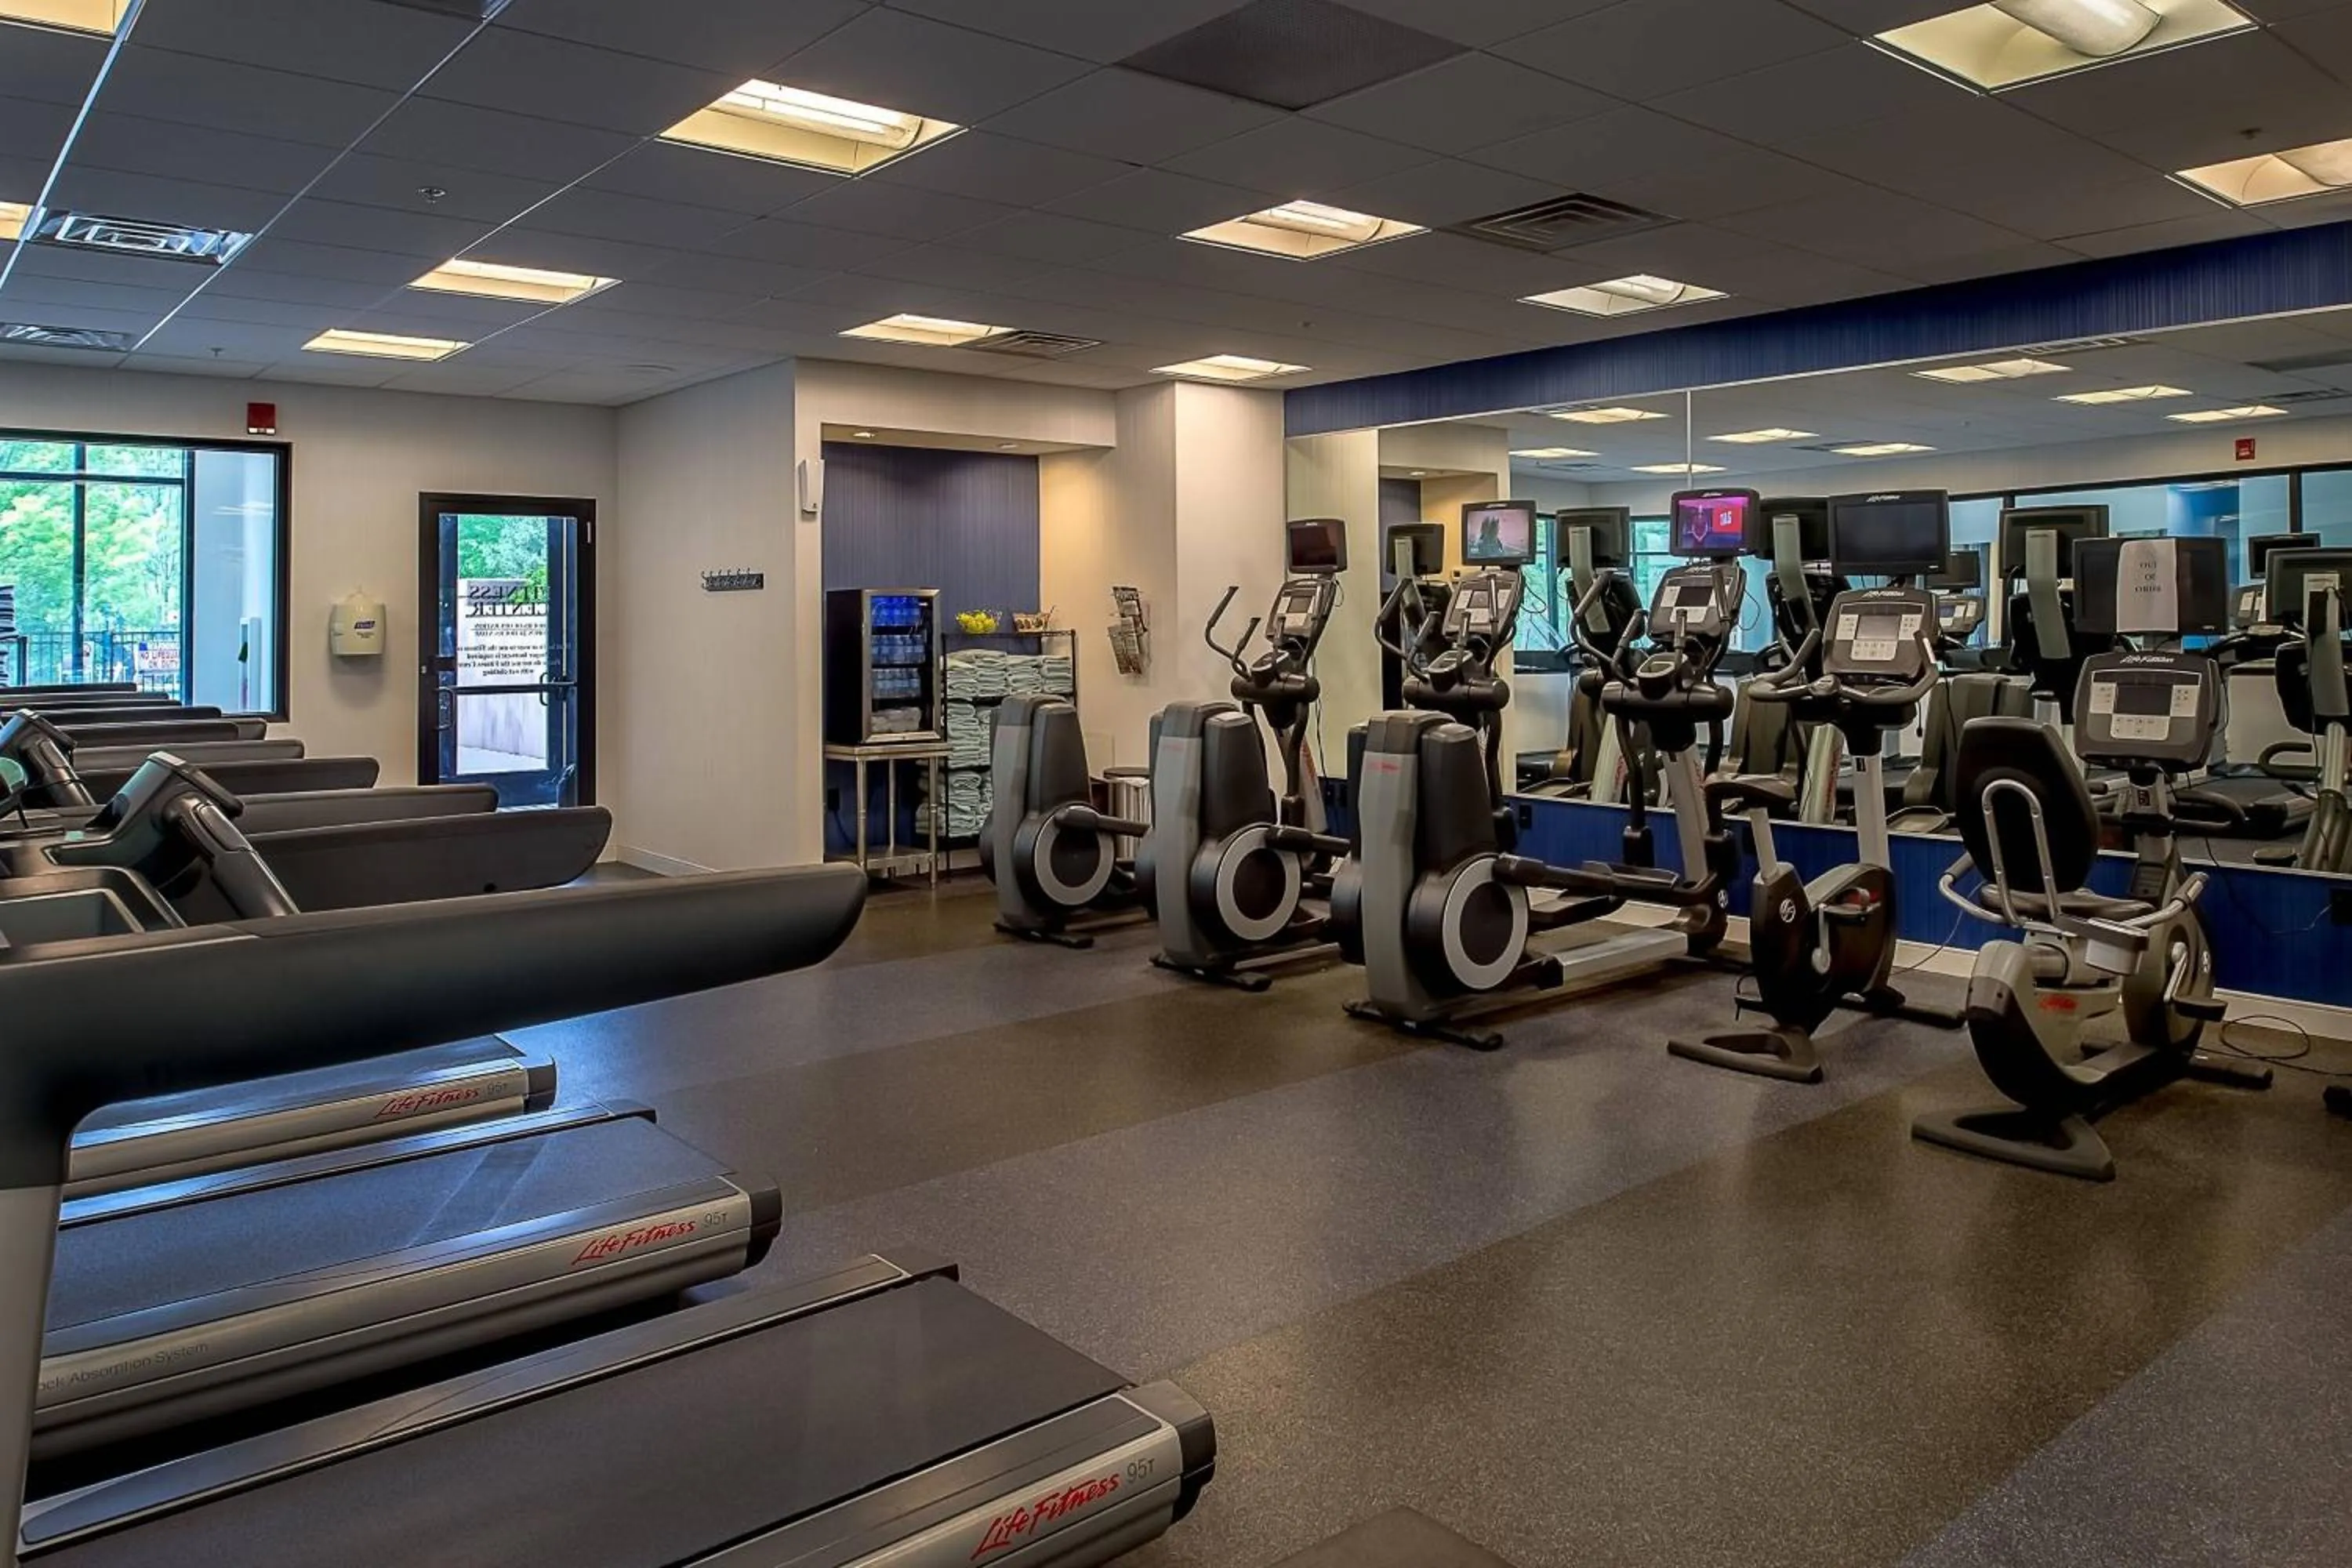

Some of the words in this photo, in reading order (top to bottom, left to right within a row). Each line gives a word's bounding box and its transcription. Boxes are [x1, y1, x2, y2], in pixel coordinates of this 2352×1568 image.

[704, 1212, 728, 1227] 95T
[38, 1377, 65, 1392] ock
[155, 1342, 209, 1365] System
[1126, 1457, 1156, 1484] 95T
